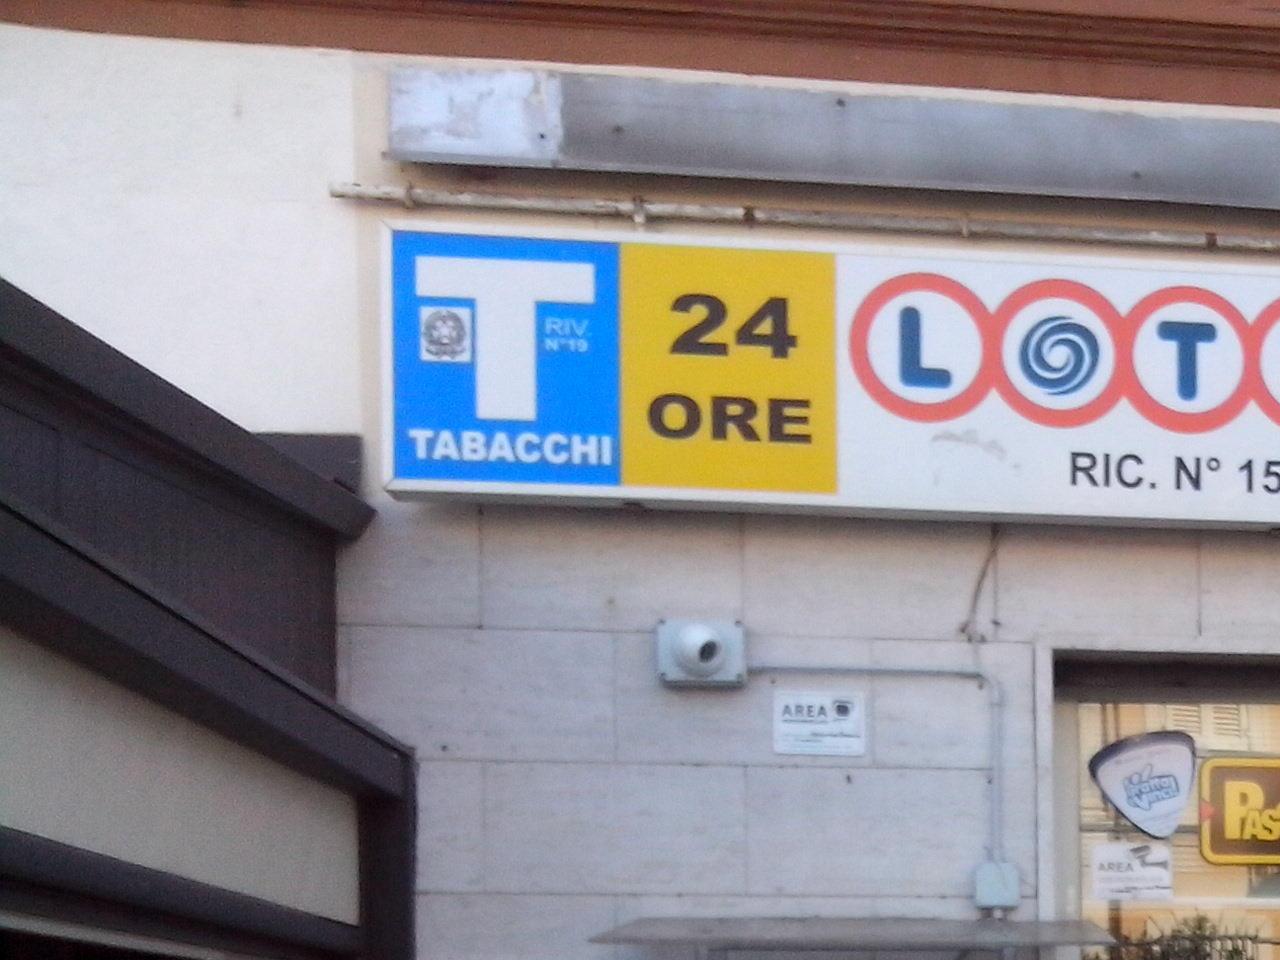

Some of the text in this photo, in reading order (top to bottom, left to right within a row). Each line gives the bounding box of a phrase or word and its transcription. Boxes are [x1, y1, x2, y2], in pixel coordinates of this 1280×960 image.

[415, 256, 595, 421] T
[671, 294, 797, 358] 24
[647, 394, 812, 443] ORE
[409, 429, 612, 465] TABACCHI
[1070, 452, 1157, 489] RIC.
[1174, 457, 1221, 491] N°
[782, 704, 827, 718] AREA
[1098, 862, 1134, 873] AREA
